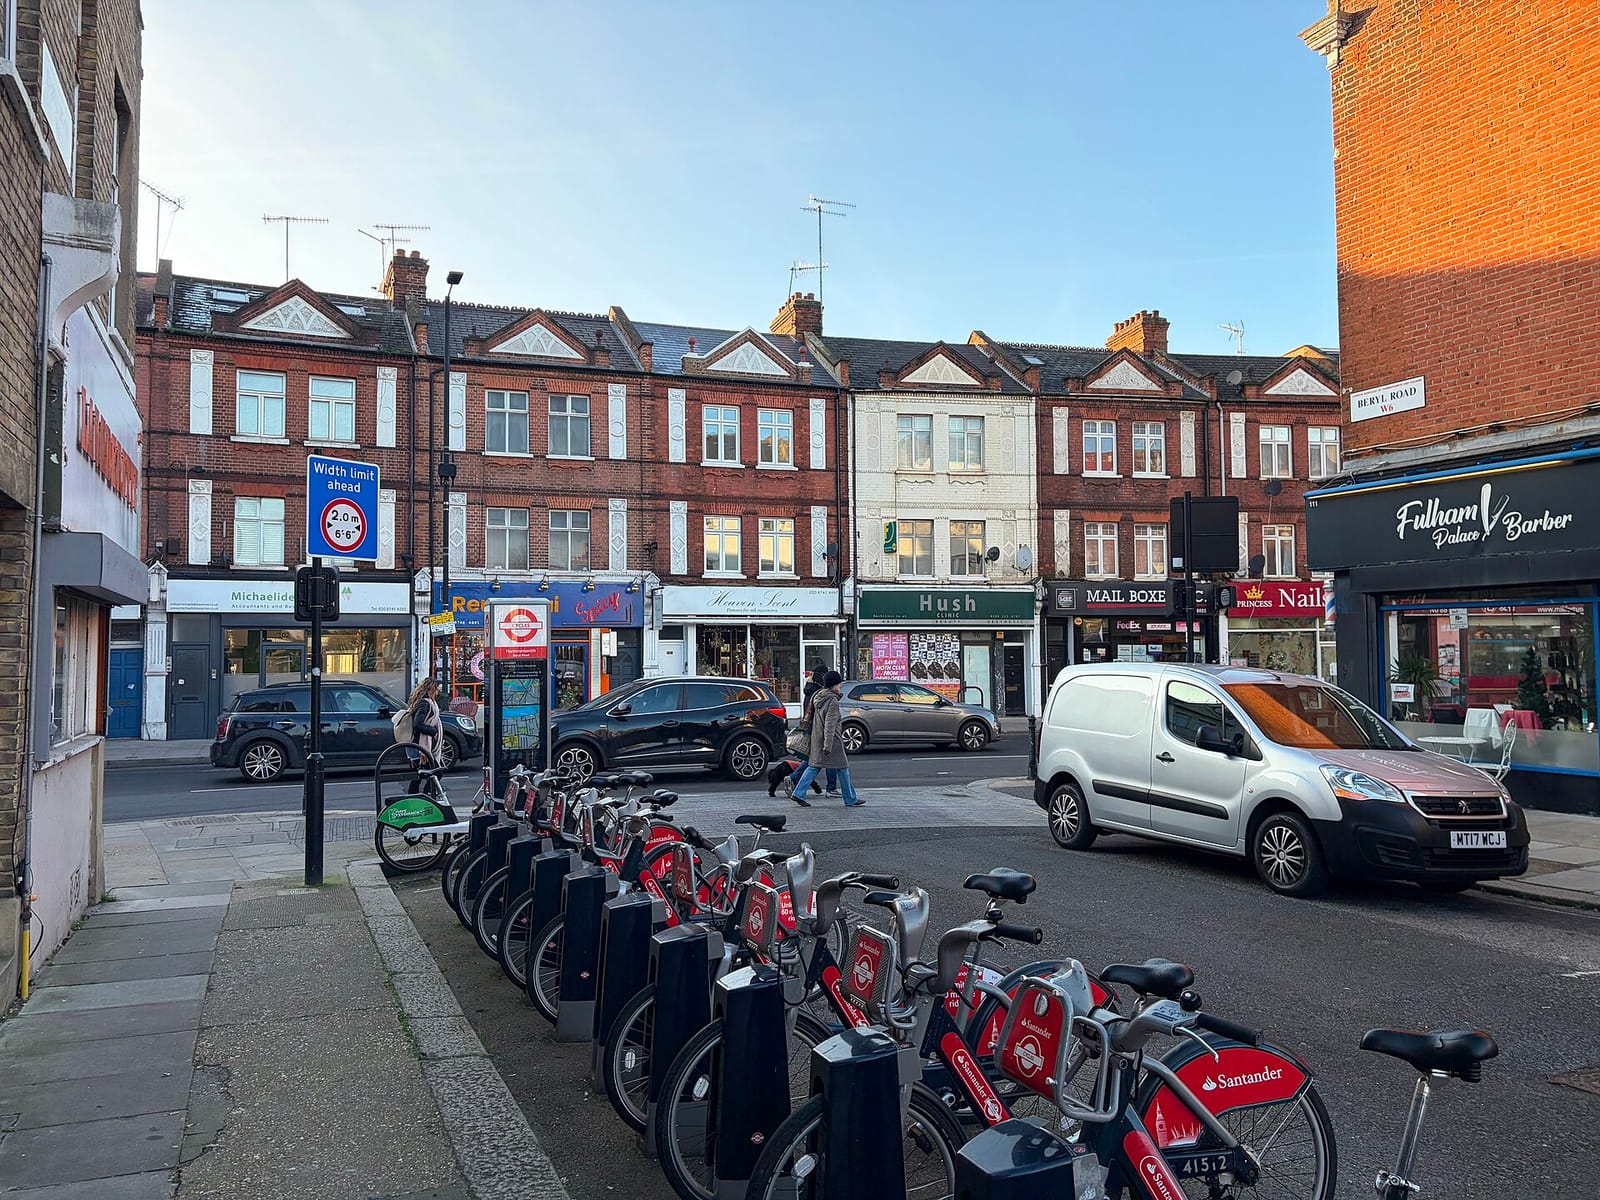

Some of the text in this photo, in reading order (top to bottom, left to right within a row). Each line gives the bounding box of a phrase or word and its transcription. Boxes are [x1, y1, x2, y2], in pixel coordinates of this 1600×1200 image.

[1357, 394, 1387, 408] BERYL
[1390, 387, 1417, 401] ROAD
[1380, 404, 1394, 413] W6
[313, 462, 375, 481] Width limit
[327, 479, 361, 493] ahead
[331, 509, 359, 523] 2.0 m
[1396, 498, 1573, 550] Fulham Palace Barber
[231, 592, 295, 602] Michaelide
[706, 590, 798, 608] Heaven Scent
[919, 594, 976, 612] Hush
[1086, 590, 1125, 602] MAIL
[1129, 590, 1166, 602] BOXE
[1236, 600, 1273, 608] PRINCESS
[575, 592, 620, 624] Spicy
[1116, 620, 1141, 629] FedEx
[649, 834, 675, 844] Santander
[1456, 833, 1501, 846] MT17 WCJ
[1025, 1020, 1052, 1039] Santander
[961, 1061, 987, 1098] Santander
[1217, 1066, 1283, 1089] Santander
[1152, 1173, 1173, 1200] Santa
